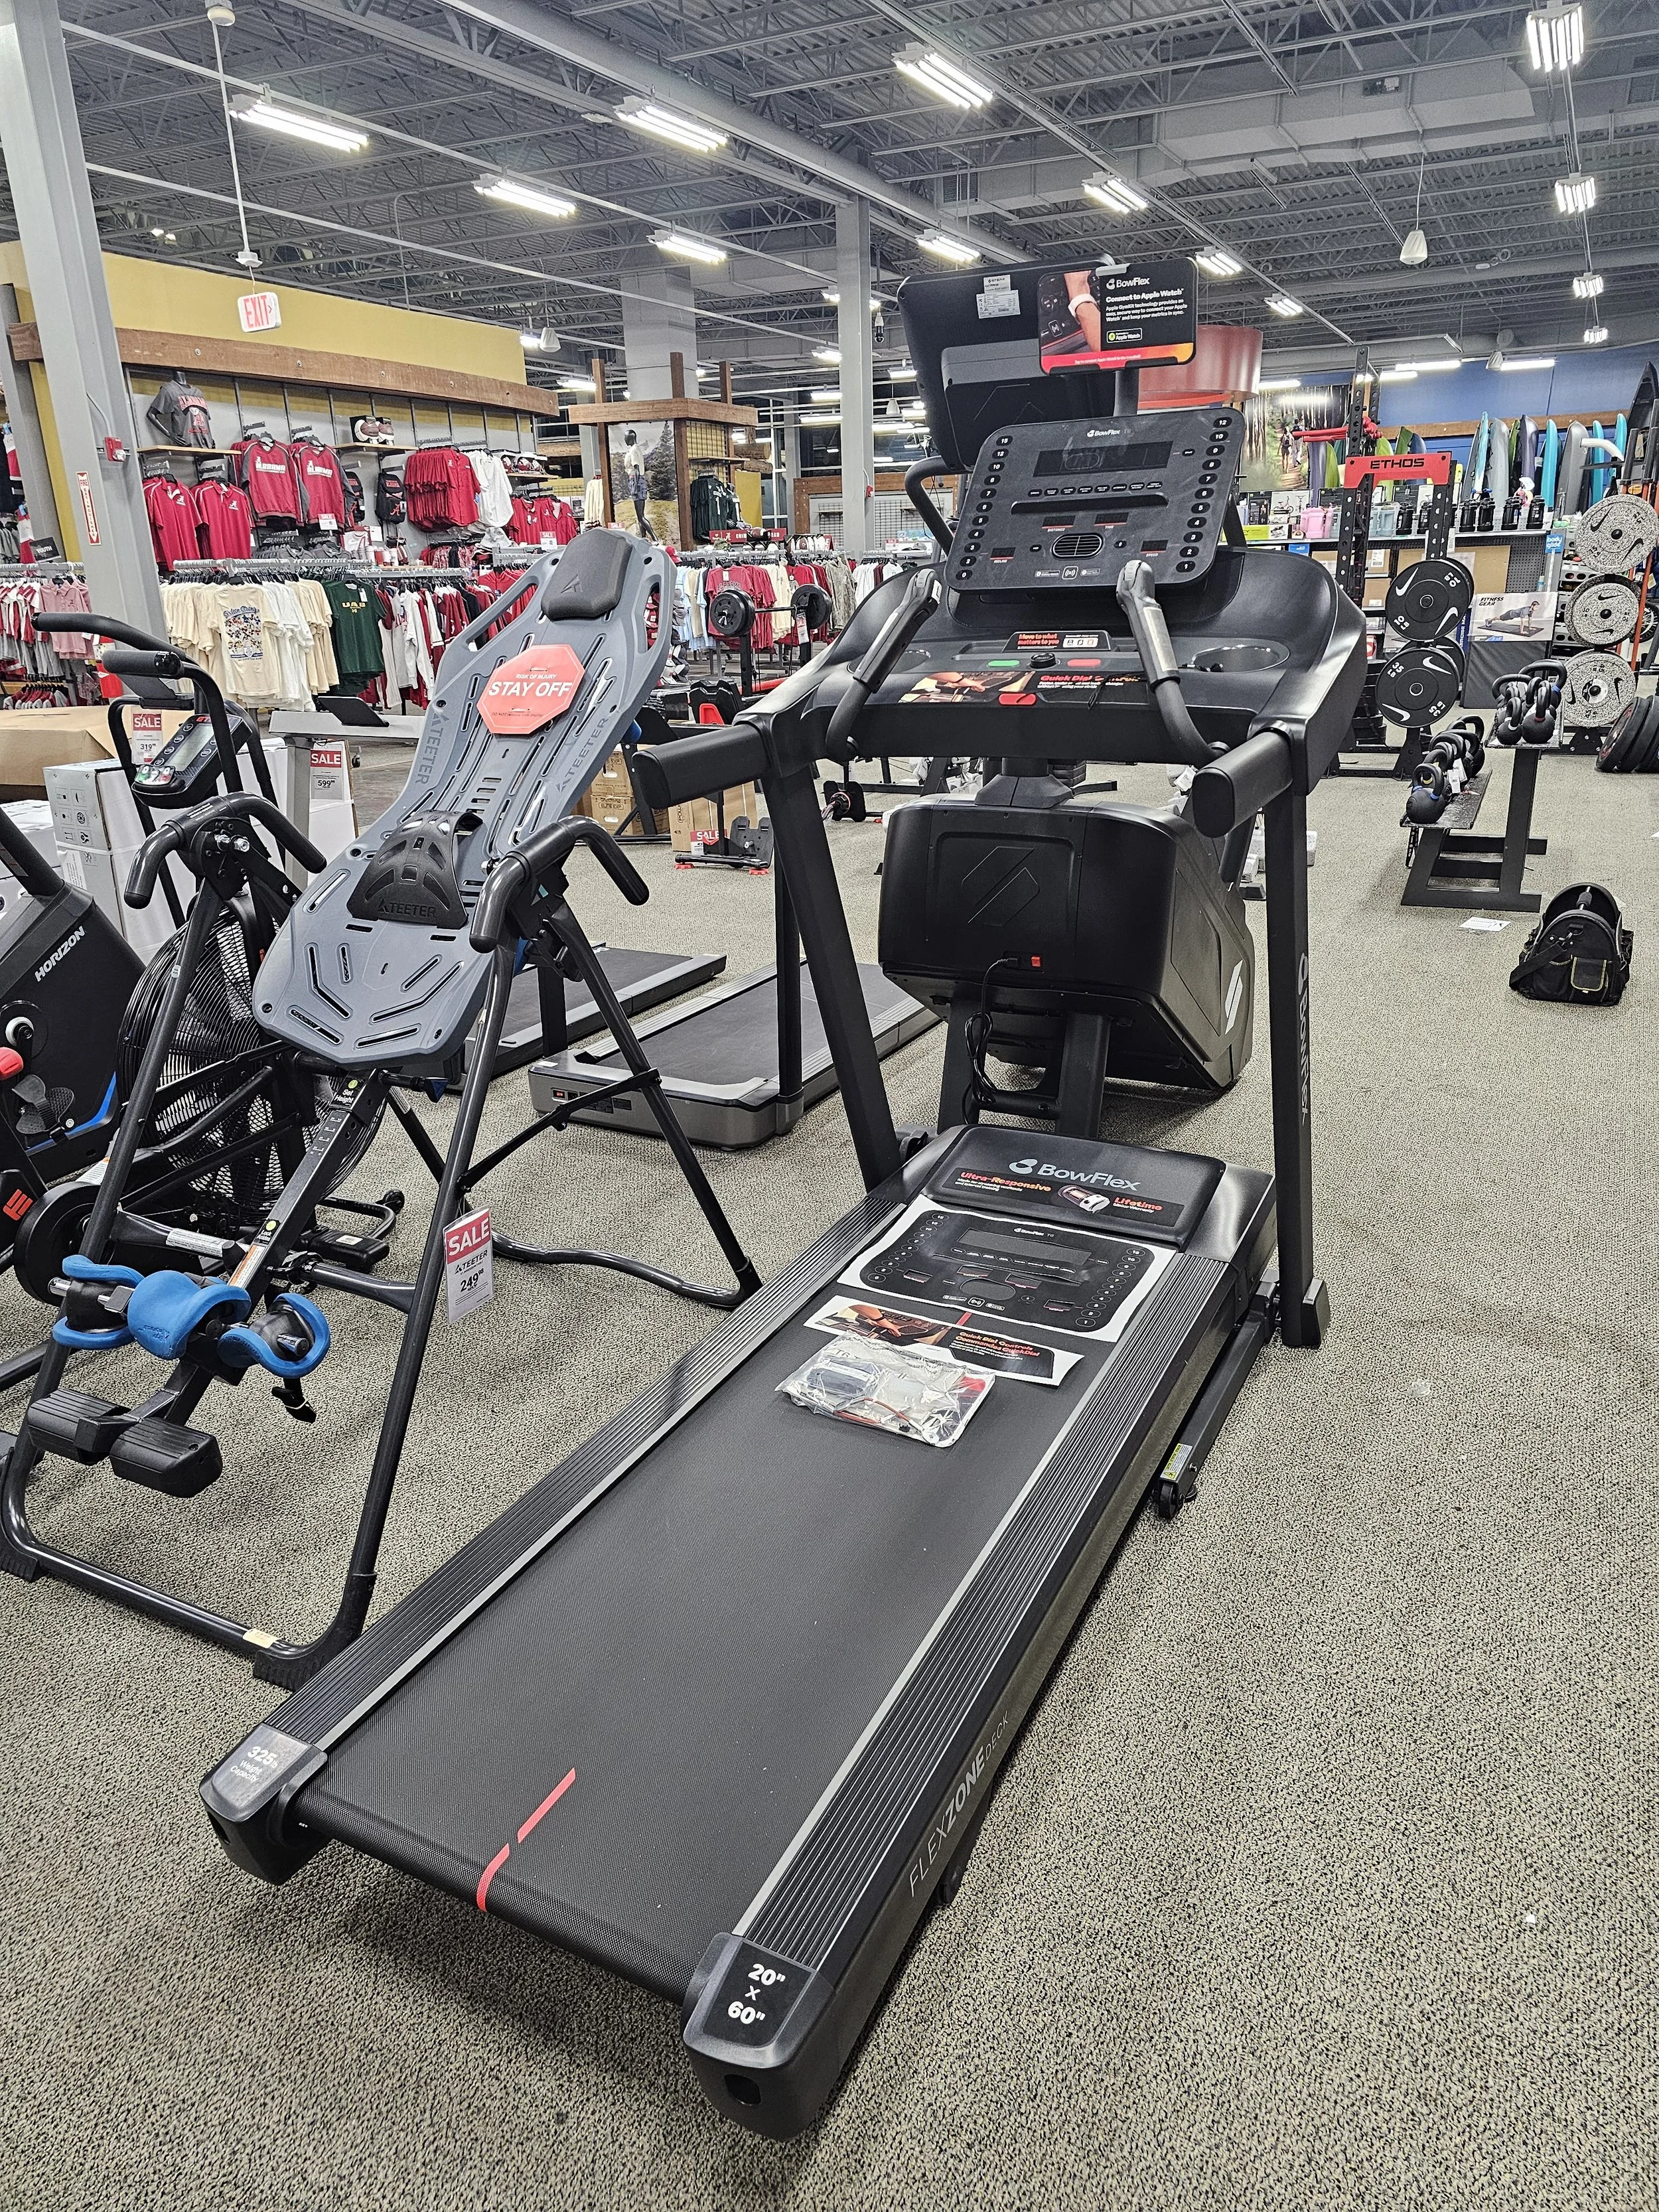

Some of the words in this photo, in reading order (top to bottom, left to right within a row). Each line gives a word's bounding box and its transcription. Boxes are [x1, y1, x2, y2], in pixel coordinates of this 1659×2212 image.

[1116, 277, 1150, 287] BowFlex
[1141, 291, 1160, 300] Apple
[244, 295, 269, 328] EXIT
[1370, 459, 1424, 469] ETHOS
[36, 546, 52, 554] YOUTH
[1444, 572, 1454, 581] LB
[1449, 577, 1461, 587] 10
[1394, 615, 1405, 627] 10
[1401, 621, 1409, 630] LB
[1387, 669, 1396, 678] LB
[1392, 662, 1404, 673] 35
[488, 682, 534, 696] STAY
[536, 682, 573, 697] OFF
[1429, 705, 1441, 717] 35
[1437, 701, 1446, 710] LB
[134, 717, 161, 727] SALE
[415, 727, 444, 785] TEETER
[562, 717, 609, 786] TEETER
[311, 754, 340, 765] SALE
[697, 831, 719, 840] SALE
[390, 904, 437, 917] TEETER
[35, 926, 86, 982] HORIZON
[334, 1095, 354, 1104] Height
[960, 1172, 1052, 1192] Ultra-Responsive
[1037, 1163, 1142, 1192] BowFlex
[1115, 1197, 1163, 1211] Lifetime
[448, 1217, 490, 1256] SALE
[462, 1250, 488, 1270] TEETER
[460, 1274, 478, 1293] 249
[478, 1268, 484, 1276] 98
[956, 1335, 1002, 1351] Commandes
[1002, 1347, 1041, 1357] QuickDial
[959, 1331, 982, 1340] Quick
[999, 1341, 1033, 1351] Controls
[240, 1759, 263, 1775] Weight
[230, 1765, 259, 1783] Capacity
[748, 1964, 786, 1985] 20"
[728, 2001, 766, 2024] 60"
